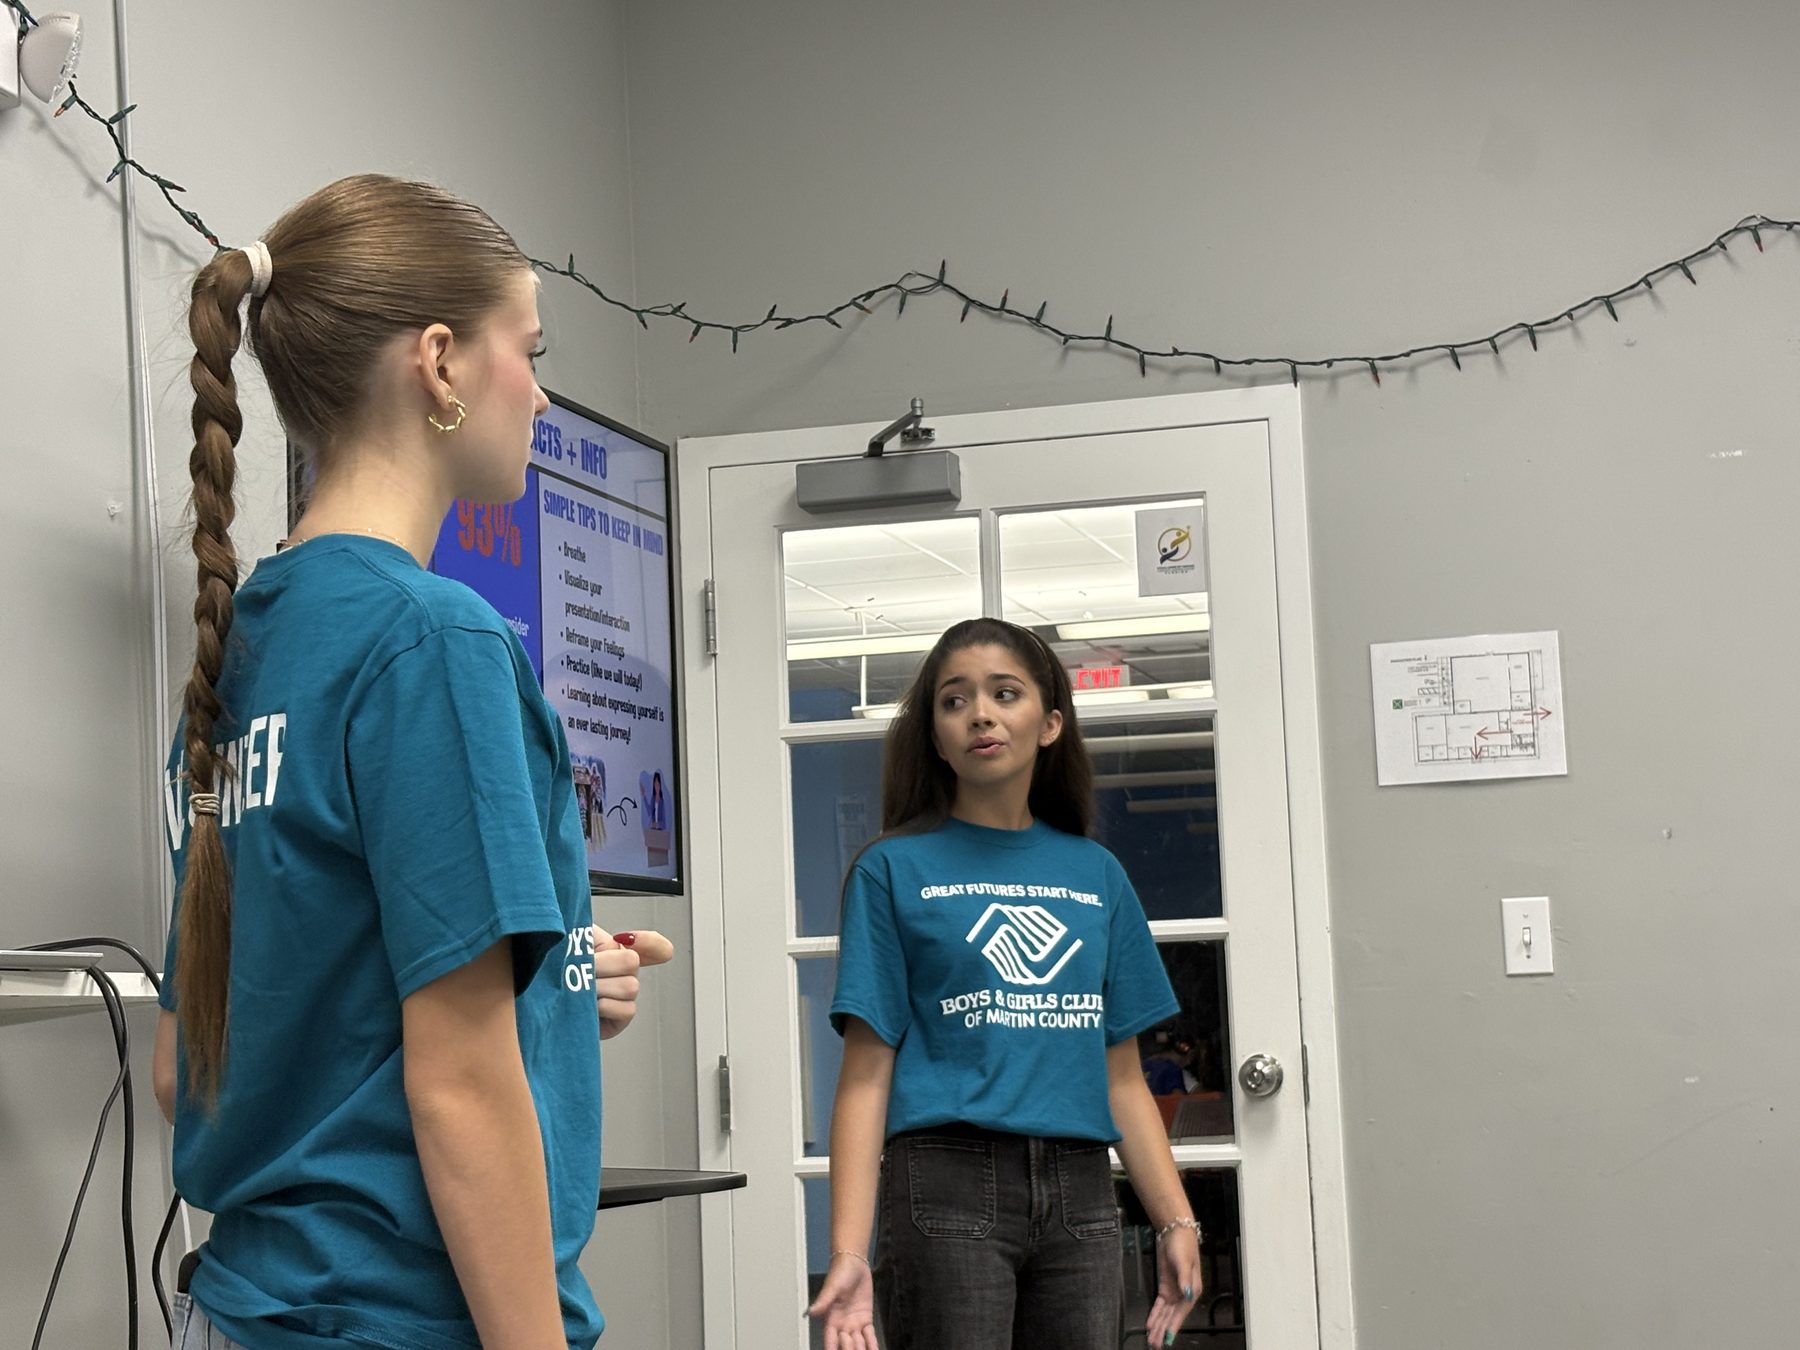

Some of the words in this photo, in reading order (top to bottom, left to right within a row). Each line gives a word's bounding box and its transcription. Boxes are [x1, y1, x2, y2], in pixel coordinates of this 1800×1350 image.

[531, 419, 562, 460] ACTS
[581, 438, 607, 480] INFO
[457, 497, 521, 567] 93%
[544, 489, 575, 522] SIMPLE
[577, 502, 596, 531] TIPS
[598, 510, 609, 536] TO
[612, 515, 631, 543] KEEP
[633, 524, 641, 548] IN
[564, 541, 586, 562] Breathe
[564, 569, 588, 591] Visualize
[590, 581, 602, 597] your
[565, 602, 630, 632] presentation/interaction
[566, 626, 589, 651] Reframe
[590, 637, 602, 653] your
[566, 655, 590, 676] Practice
[591, 660, 603, 679] (like
[604, 668, 612, 681] we
[613, 669, 623, 685] will
[624, 671, 642, 692] today!)
[567, 683, 591, 708] Learning
[592, 690, 607, 708] about
[608, 698, 637, 719] expressing
[637, 705, 658, 720] yourself
[659, 707, 664, 722] is
[568, 716, 575, 729] an
[576, 718, 589, 731] ever
[590, 718, 609, 740] lasting
[610, 722, 631, 745] journey!
[920, 884, 965, 900] GREAT
[965, 882, 1025, 897] FUTURES
[1026, 885, 1068, 899] START
[566, 926, 594, 957] YS
[565, 963, 593, 992] OF
[940, 989, 991, 1015] BOYS
[995, 989, 1005, 1007] &
[1006, 992, 1058, 1010] GIRLS
[964, 1010, 983, 1028] OF
[986, 1008, 1036, 1029] MARTIN
[1038, 1011, 1101, 1029] COUNTY
